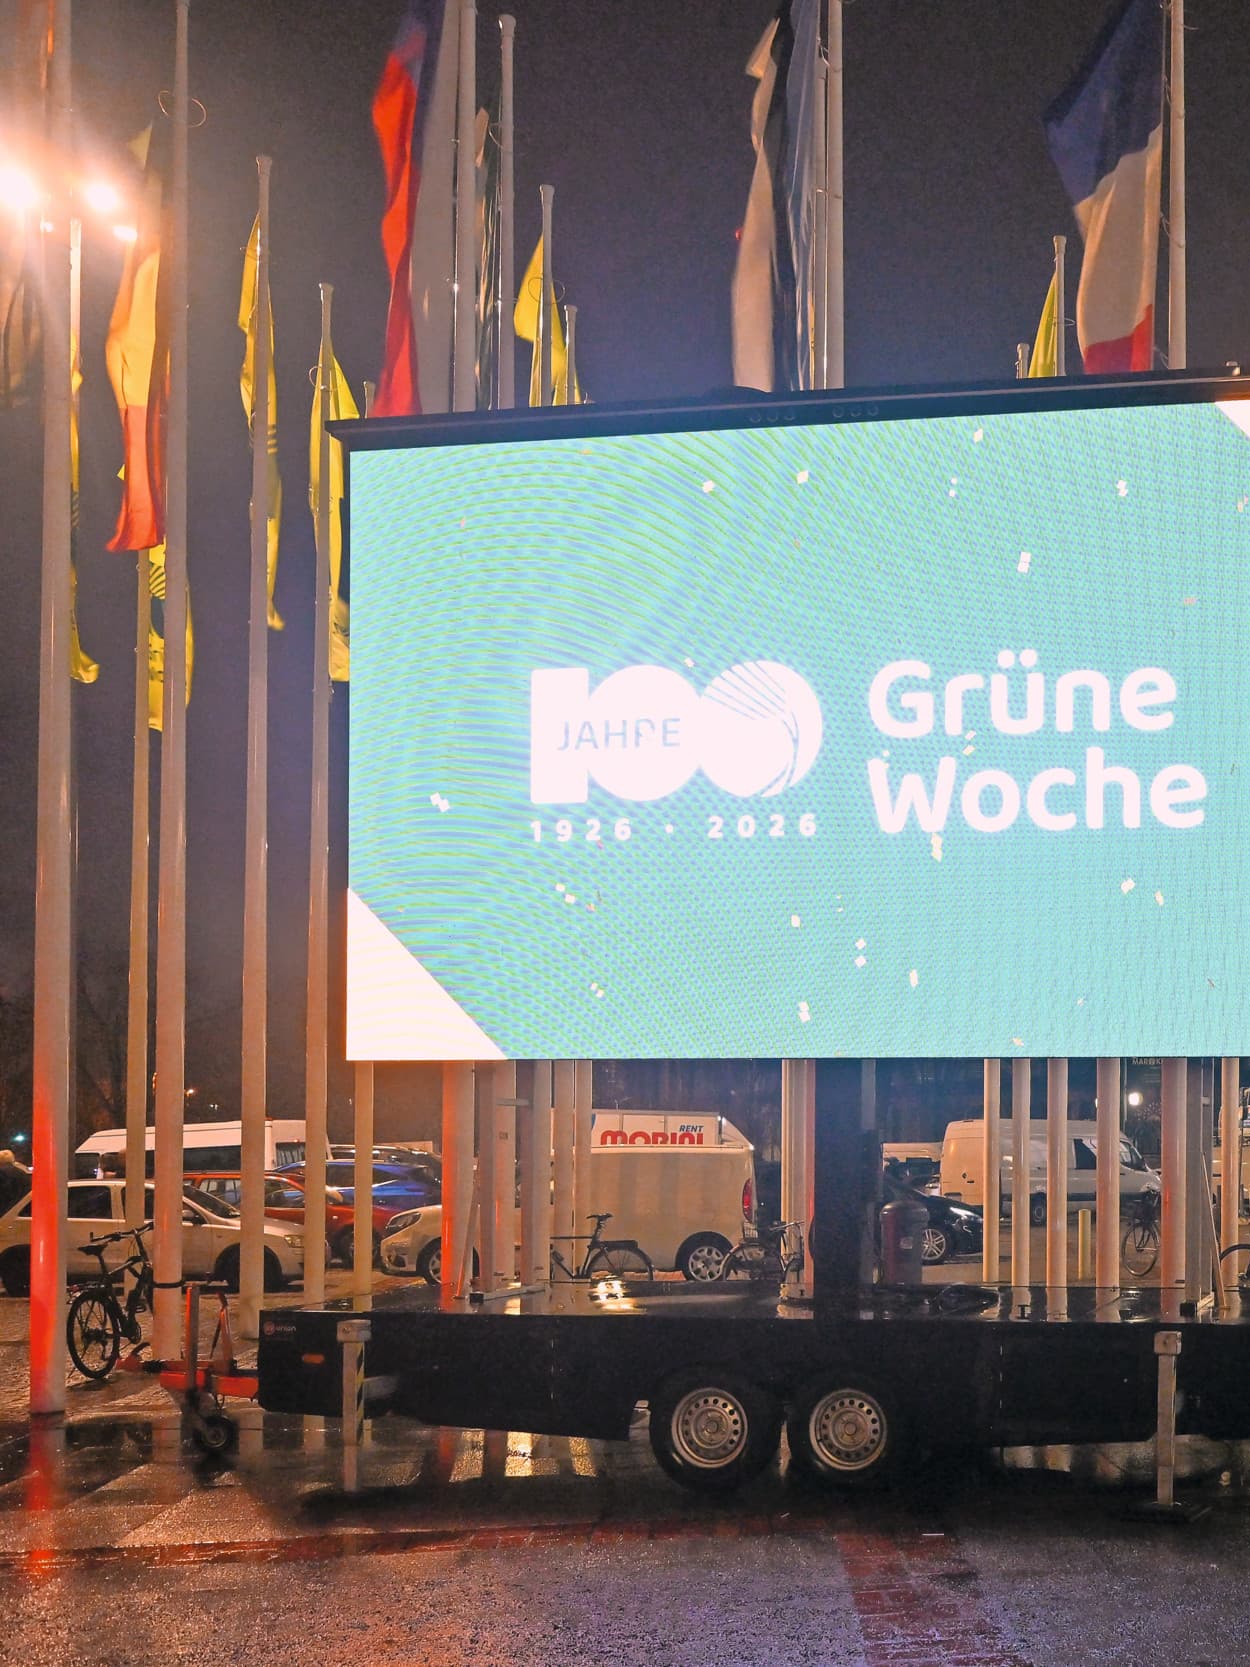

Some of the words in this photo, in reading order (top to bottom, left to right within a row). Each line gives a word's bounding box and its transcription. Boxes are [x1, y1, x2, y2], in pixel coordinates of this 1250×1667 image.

[530, 660, 823, 804] 100
[868, 648, 1178, 739] Grüne
[531, 818, 632, 843] 1926
[708, 813, 817, 839] 2026
[866, 745, 1208, 834] Woche
